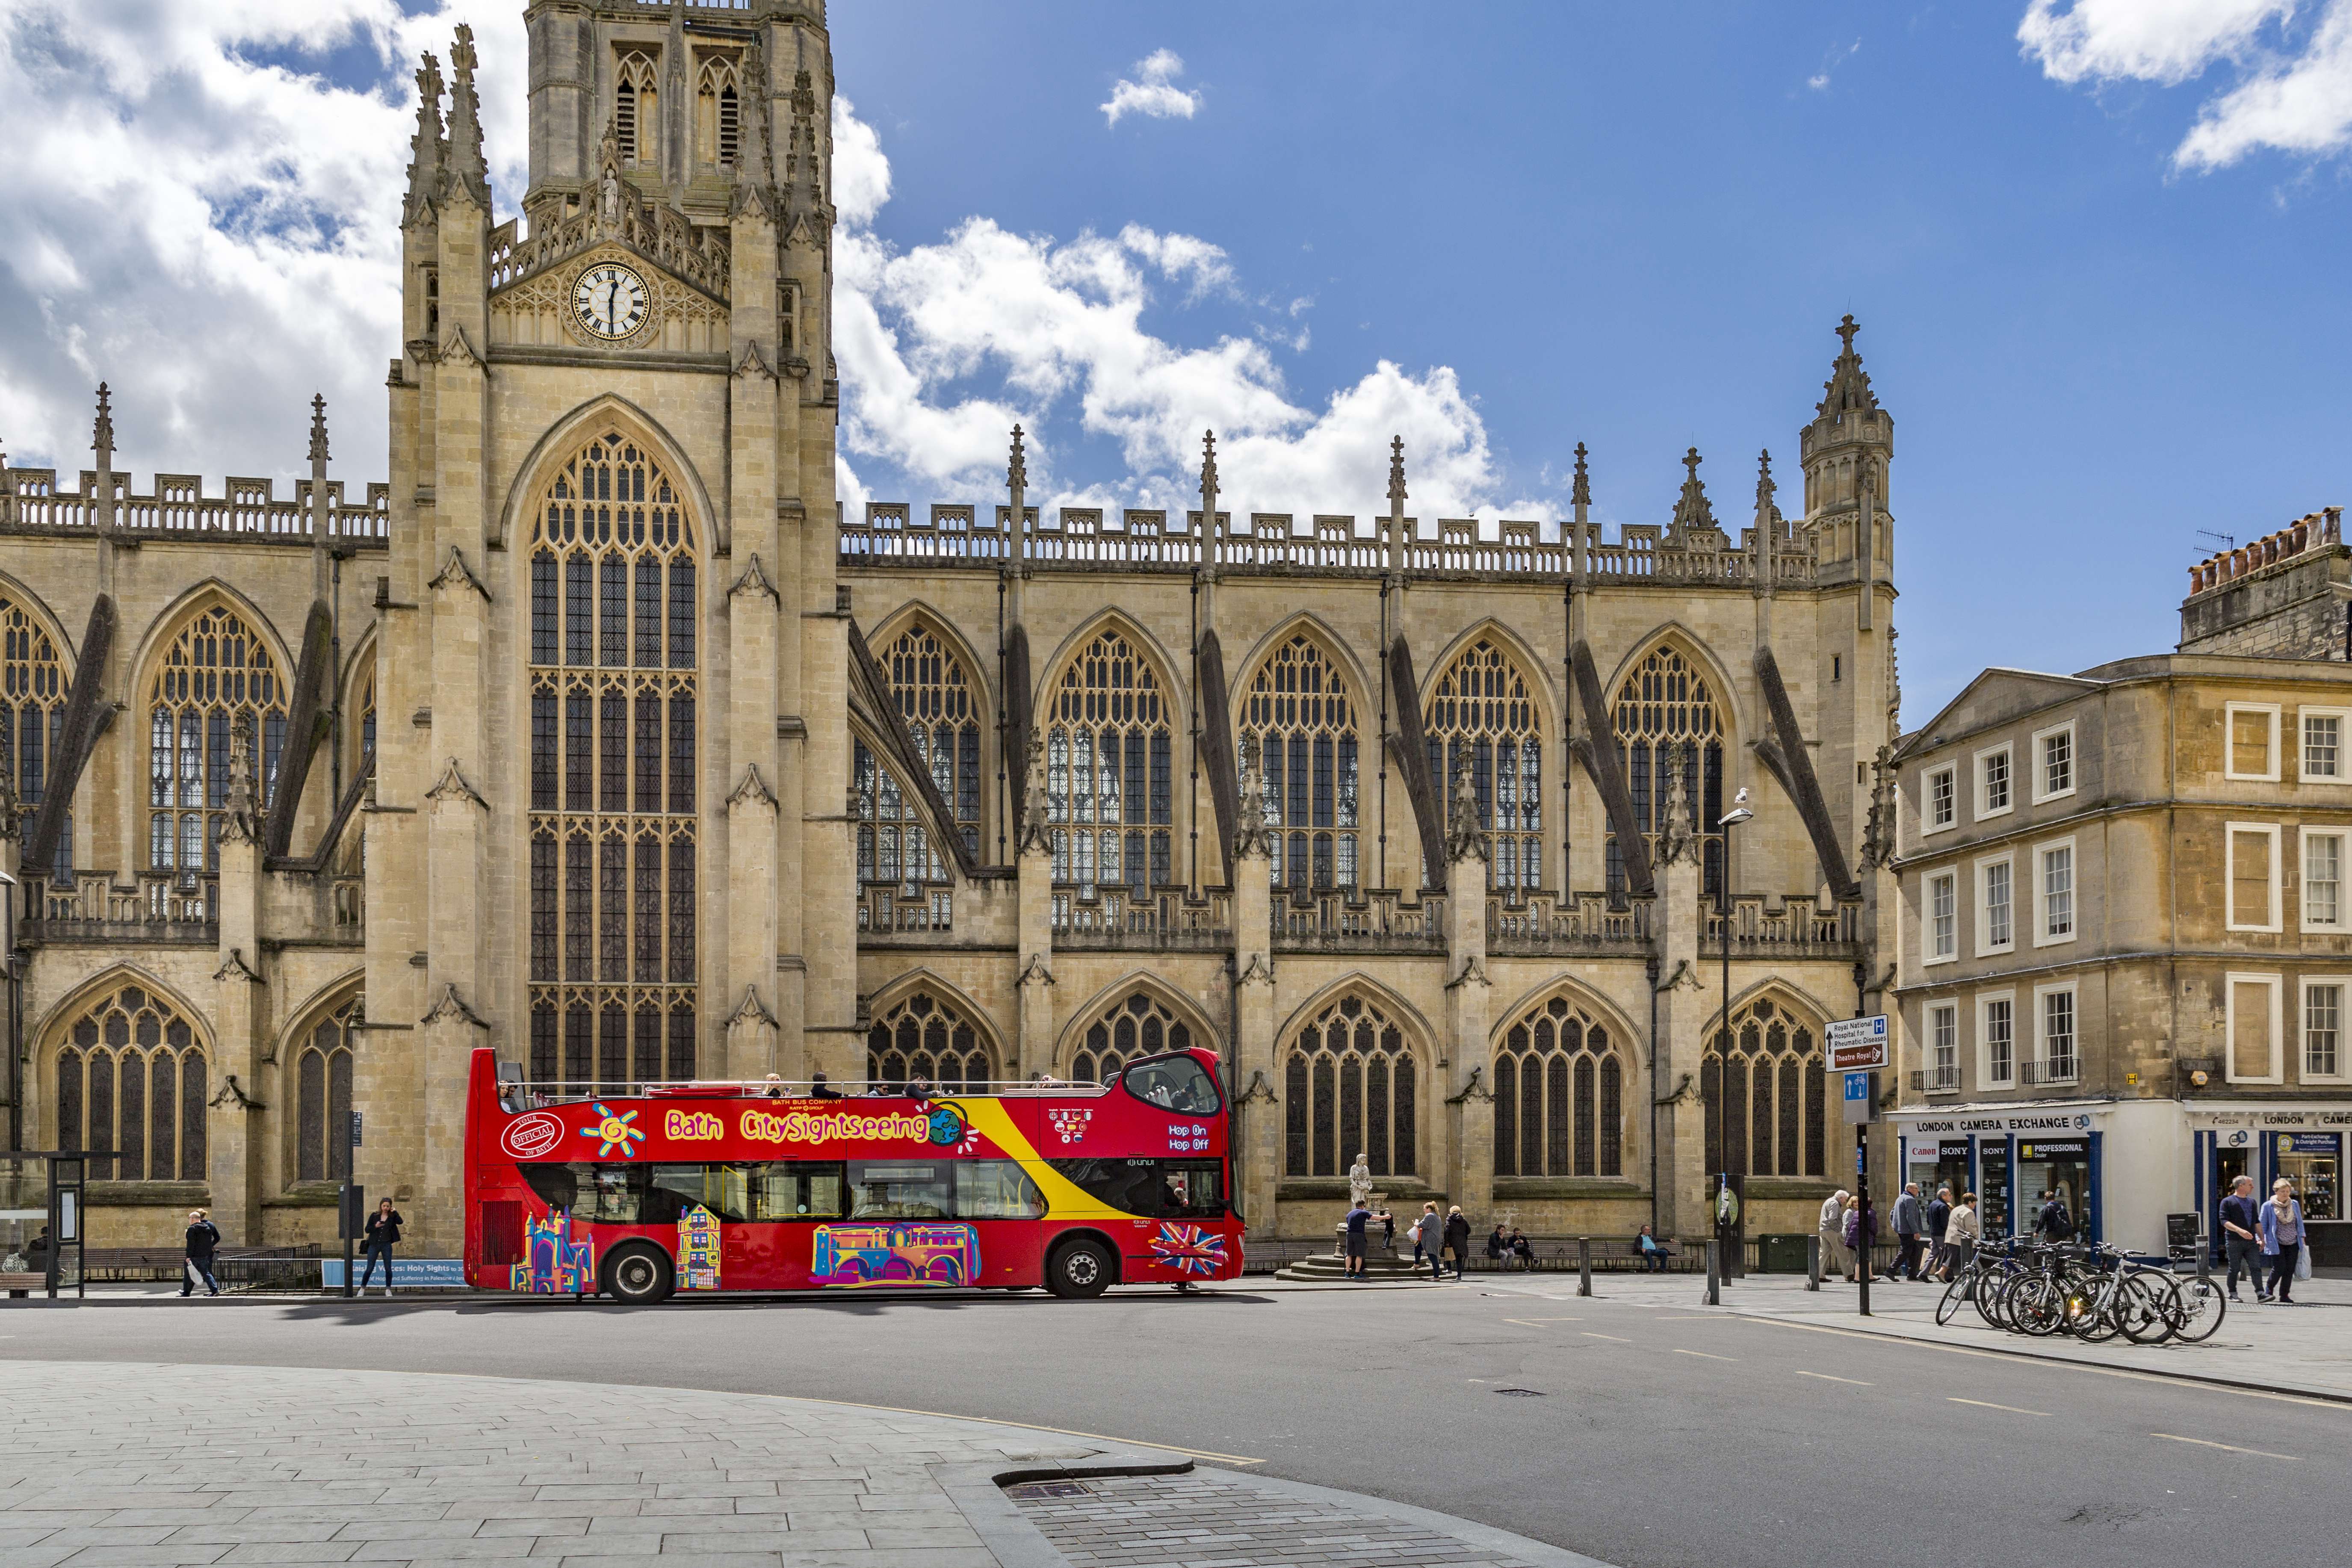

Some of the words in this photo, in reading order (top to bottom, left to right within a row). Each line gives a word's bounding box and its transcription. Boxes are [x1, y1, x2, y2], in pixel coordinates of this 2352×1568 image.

[1834, 1023, 1848, 1031] Royal
[1850, 1020, 1872, 1029] National
[1876, 1020, 1883, 1033] H
[1834, 1031, 1856, 1040] Hospital
[1834, 1038, 1862, 1047] Rheumatic
[1856, 1051, 1871, 1060] Royal
[517, 1116, 537, 1126] TOUR
[665, 1110, 723, 1140] Bath
[1917, 1122, 1954, 1132] LONDON
[1960, 1119, 2003, 1131] CAMERA
[2009, 1117, 2069, 1129] EXCHANGE
[513, 1126, 553, 1145] OFFICIAL
[1169, 1125, 1189, 1137] Hop
[1192, 1124, 1206, 1136] On
[536, 1142, 553, 1154] BATH
[1169, 1139, 1190, 1151] Hop
[1193, 1139, 1209, 1150] Off
